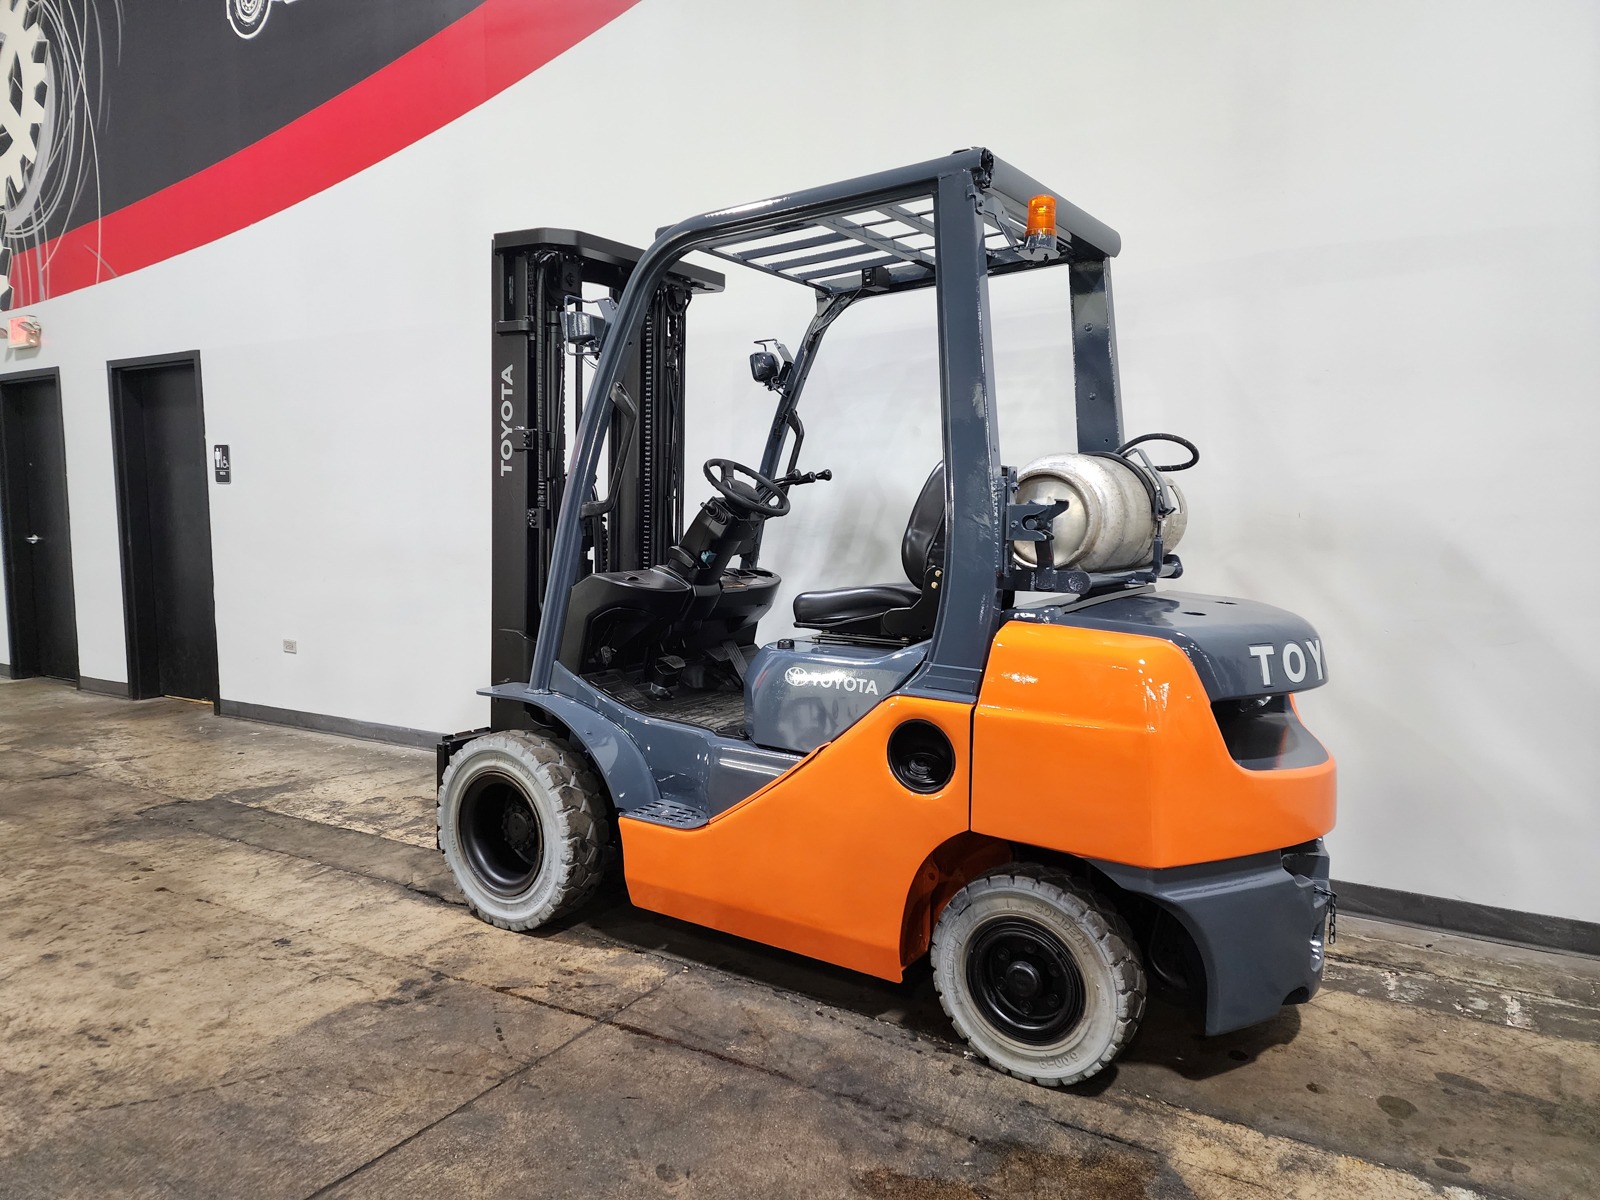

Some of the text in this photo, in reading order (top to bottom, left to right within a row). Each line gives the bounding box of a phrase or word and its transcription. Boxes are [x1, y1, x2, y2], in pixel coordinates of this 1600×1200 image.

[501, 363, 513, 477] TOYOTA
[810, 671, 879, 696] TOYOTA
[1248, 639, 1323, 686] TOY
